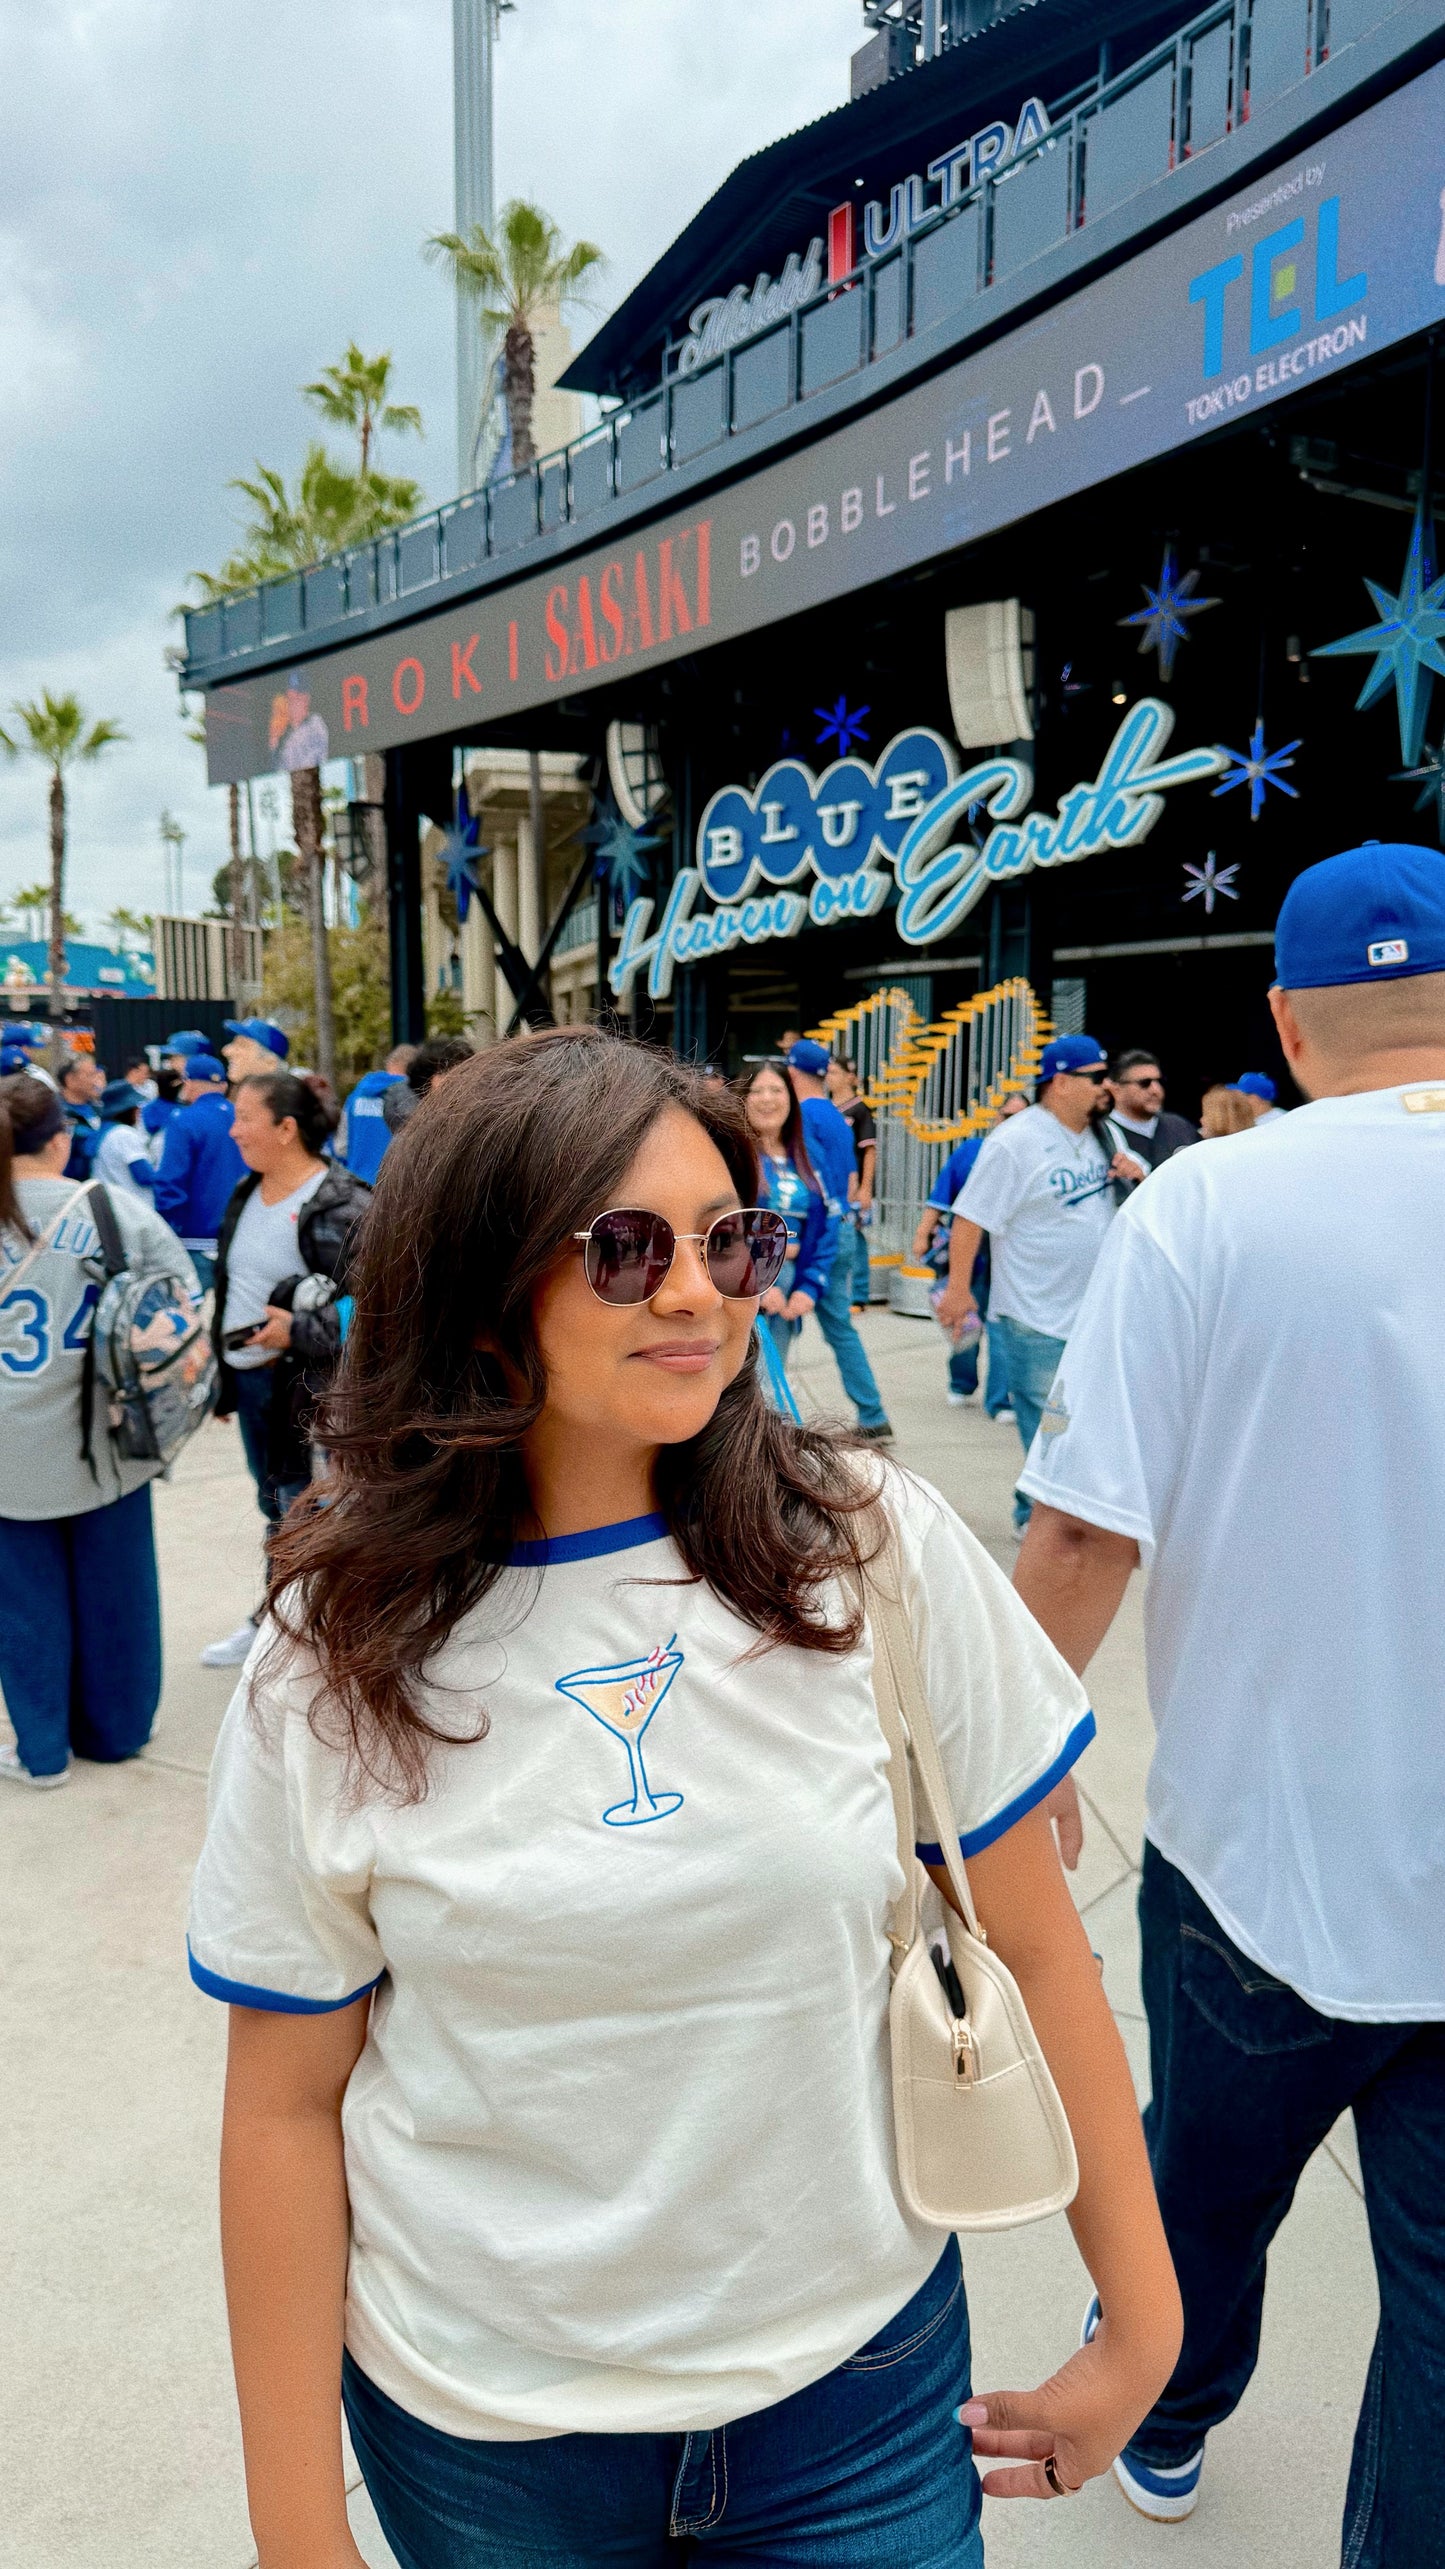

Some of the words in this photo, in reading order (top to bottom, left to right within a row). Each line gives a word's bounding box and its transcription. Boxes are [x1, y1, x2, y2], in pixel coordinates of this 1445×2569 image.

[864, 97, 1057, 258] ULTRA
[1226, 173, 1303, 235] Presented
[1304, 162, 1327, 187] by
[1188, 194, 1368, 380] TEL
[1185, 374, 1250, 425] TOKYO
[1255, 315, 1368, 393] ELECTRON
[342, 621, 519, 732] ROKI
[544, 518, 715, 683] SASAKI
[607, 867, 799, 998] Heaven
[809, 868, 892, 926] on
[895, 697, 1230, 945] Earth
[705, 768, 931, 869] BLUE
